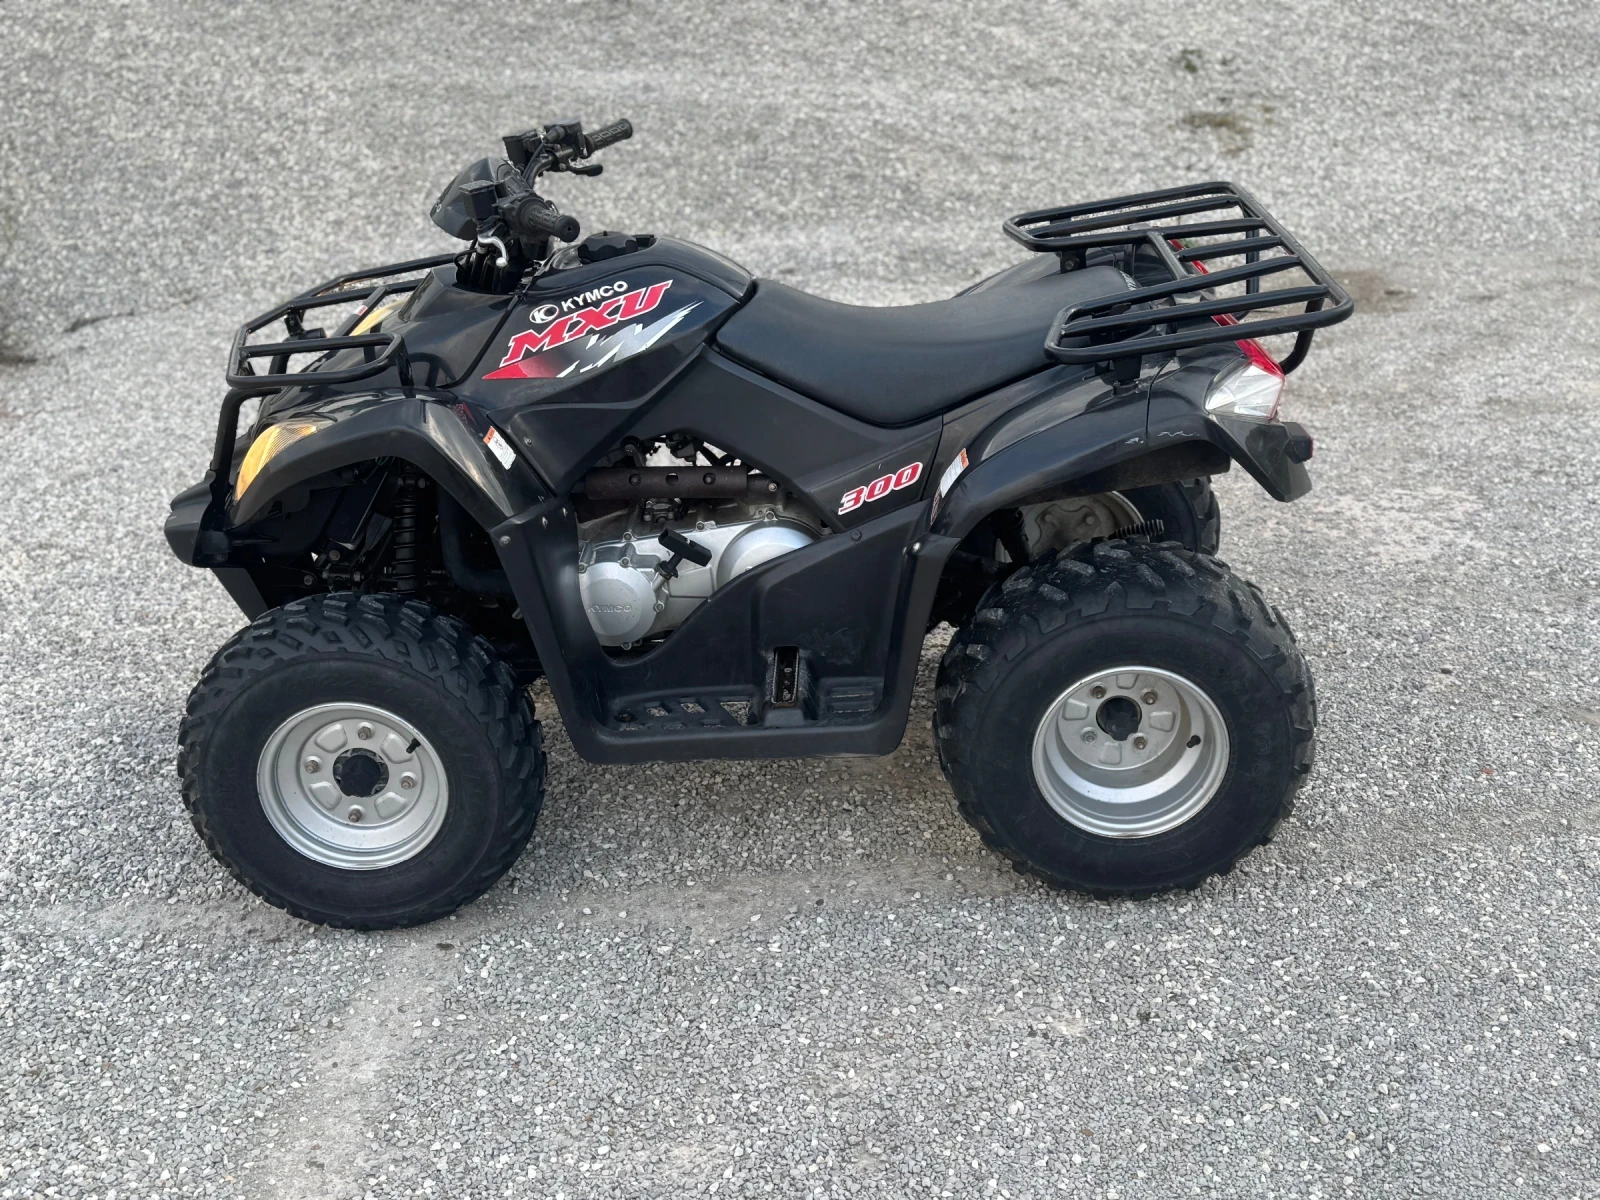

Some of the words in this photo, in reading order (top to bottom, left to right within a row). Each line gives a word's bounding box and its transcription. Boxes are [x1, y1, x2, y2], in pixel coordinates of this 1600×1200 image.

[561, 280, 628, 312] KYMCO
[499, 279, 674, 368] MXU
[838, 462, 923, 515] 300
[588, 604, 632, 613] KYMCO
